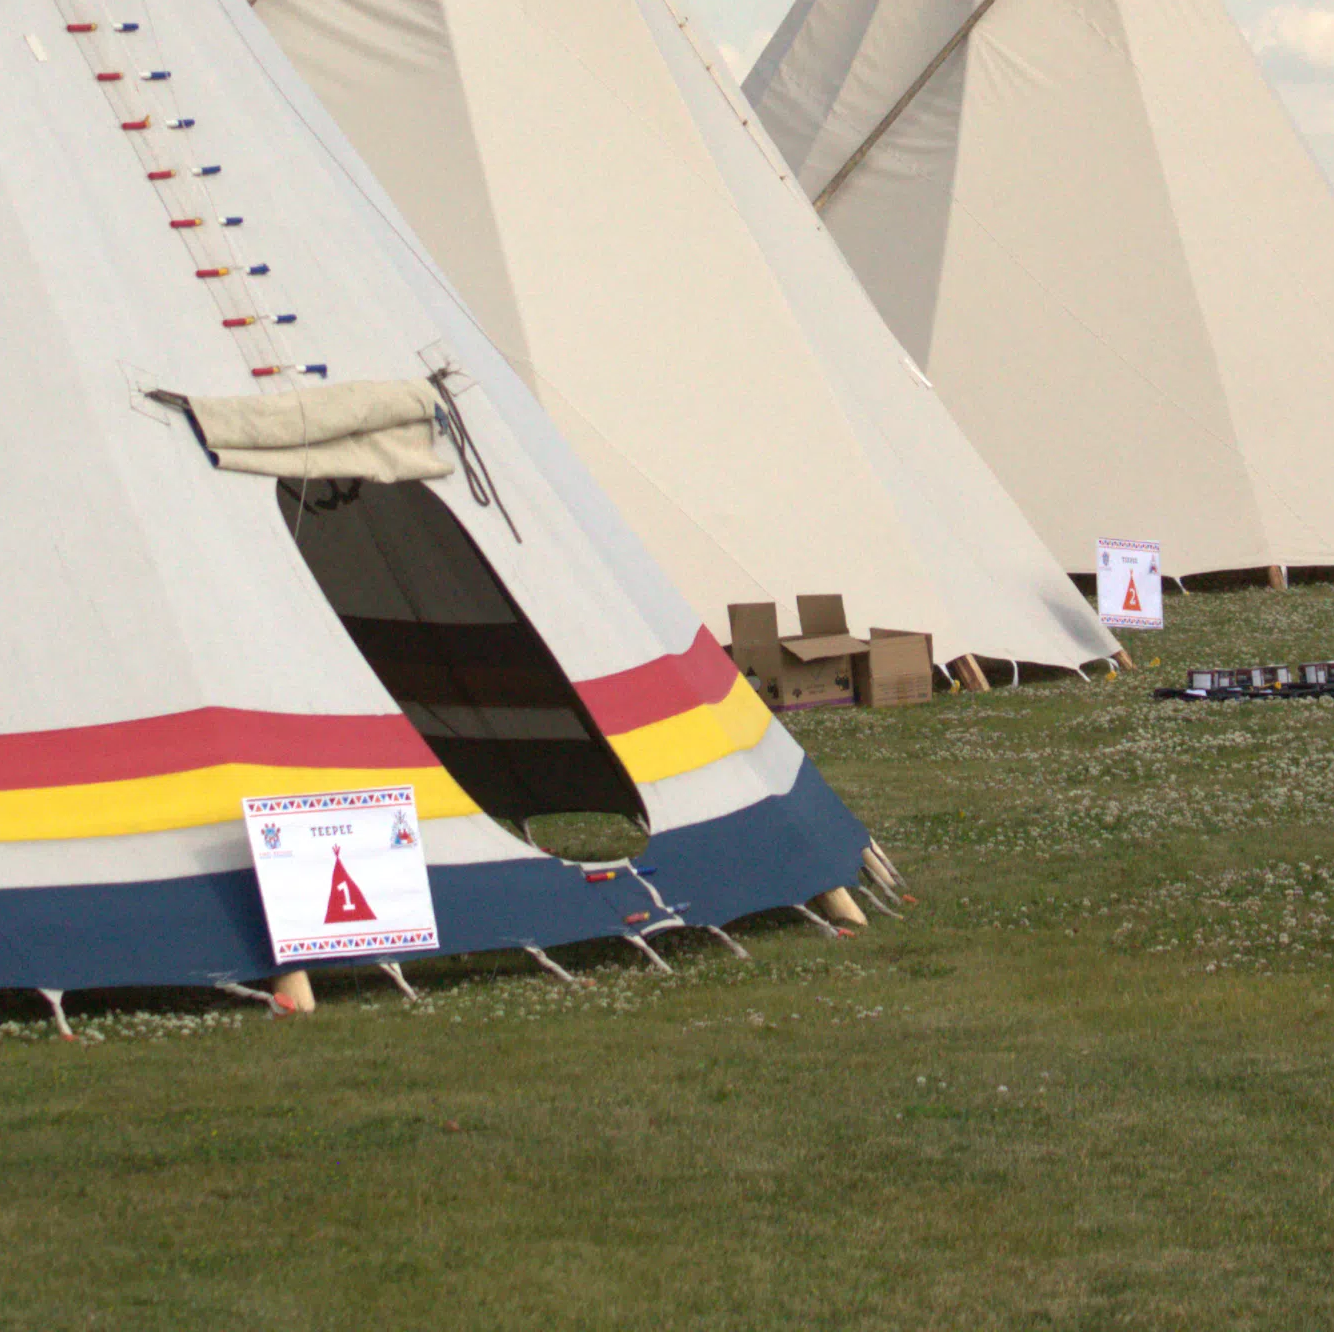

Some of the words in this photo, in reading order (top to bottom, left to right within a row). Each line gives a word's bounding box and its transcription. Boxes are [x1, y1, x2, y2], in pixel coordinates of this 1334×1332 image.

[1129, 588, 1136, 605] 2
[310, 824, 354, 837] TEEPEE
[336, 880, 356, 911] 1
